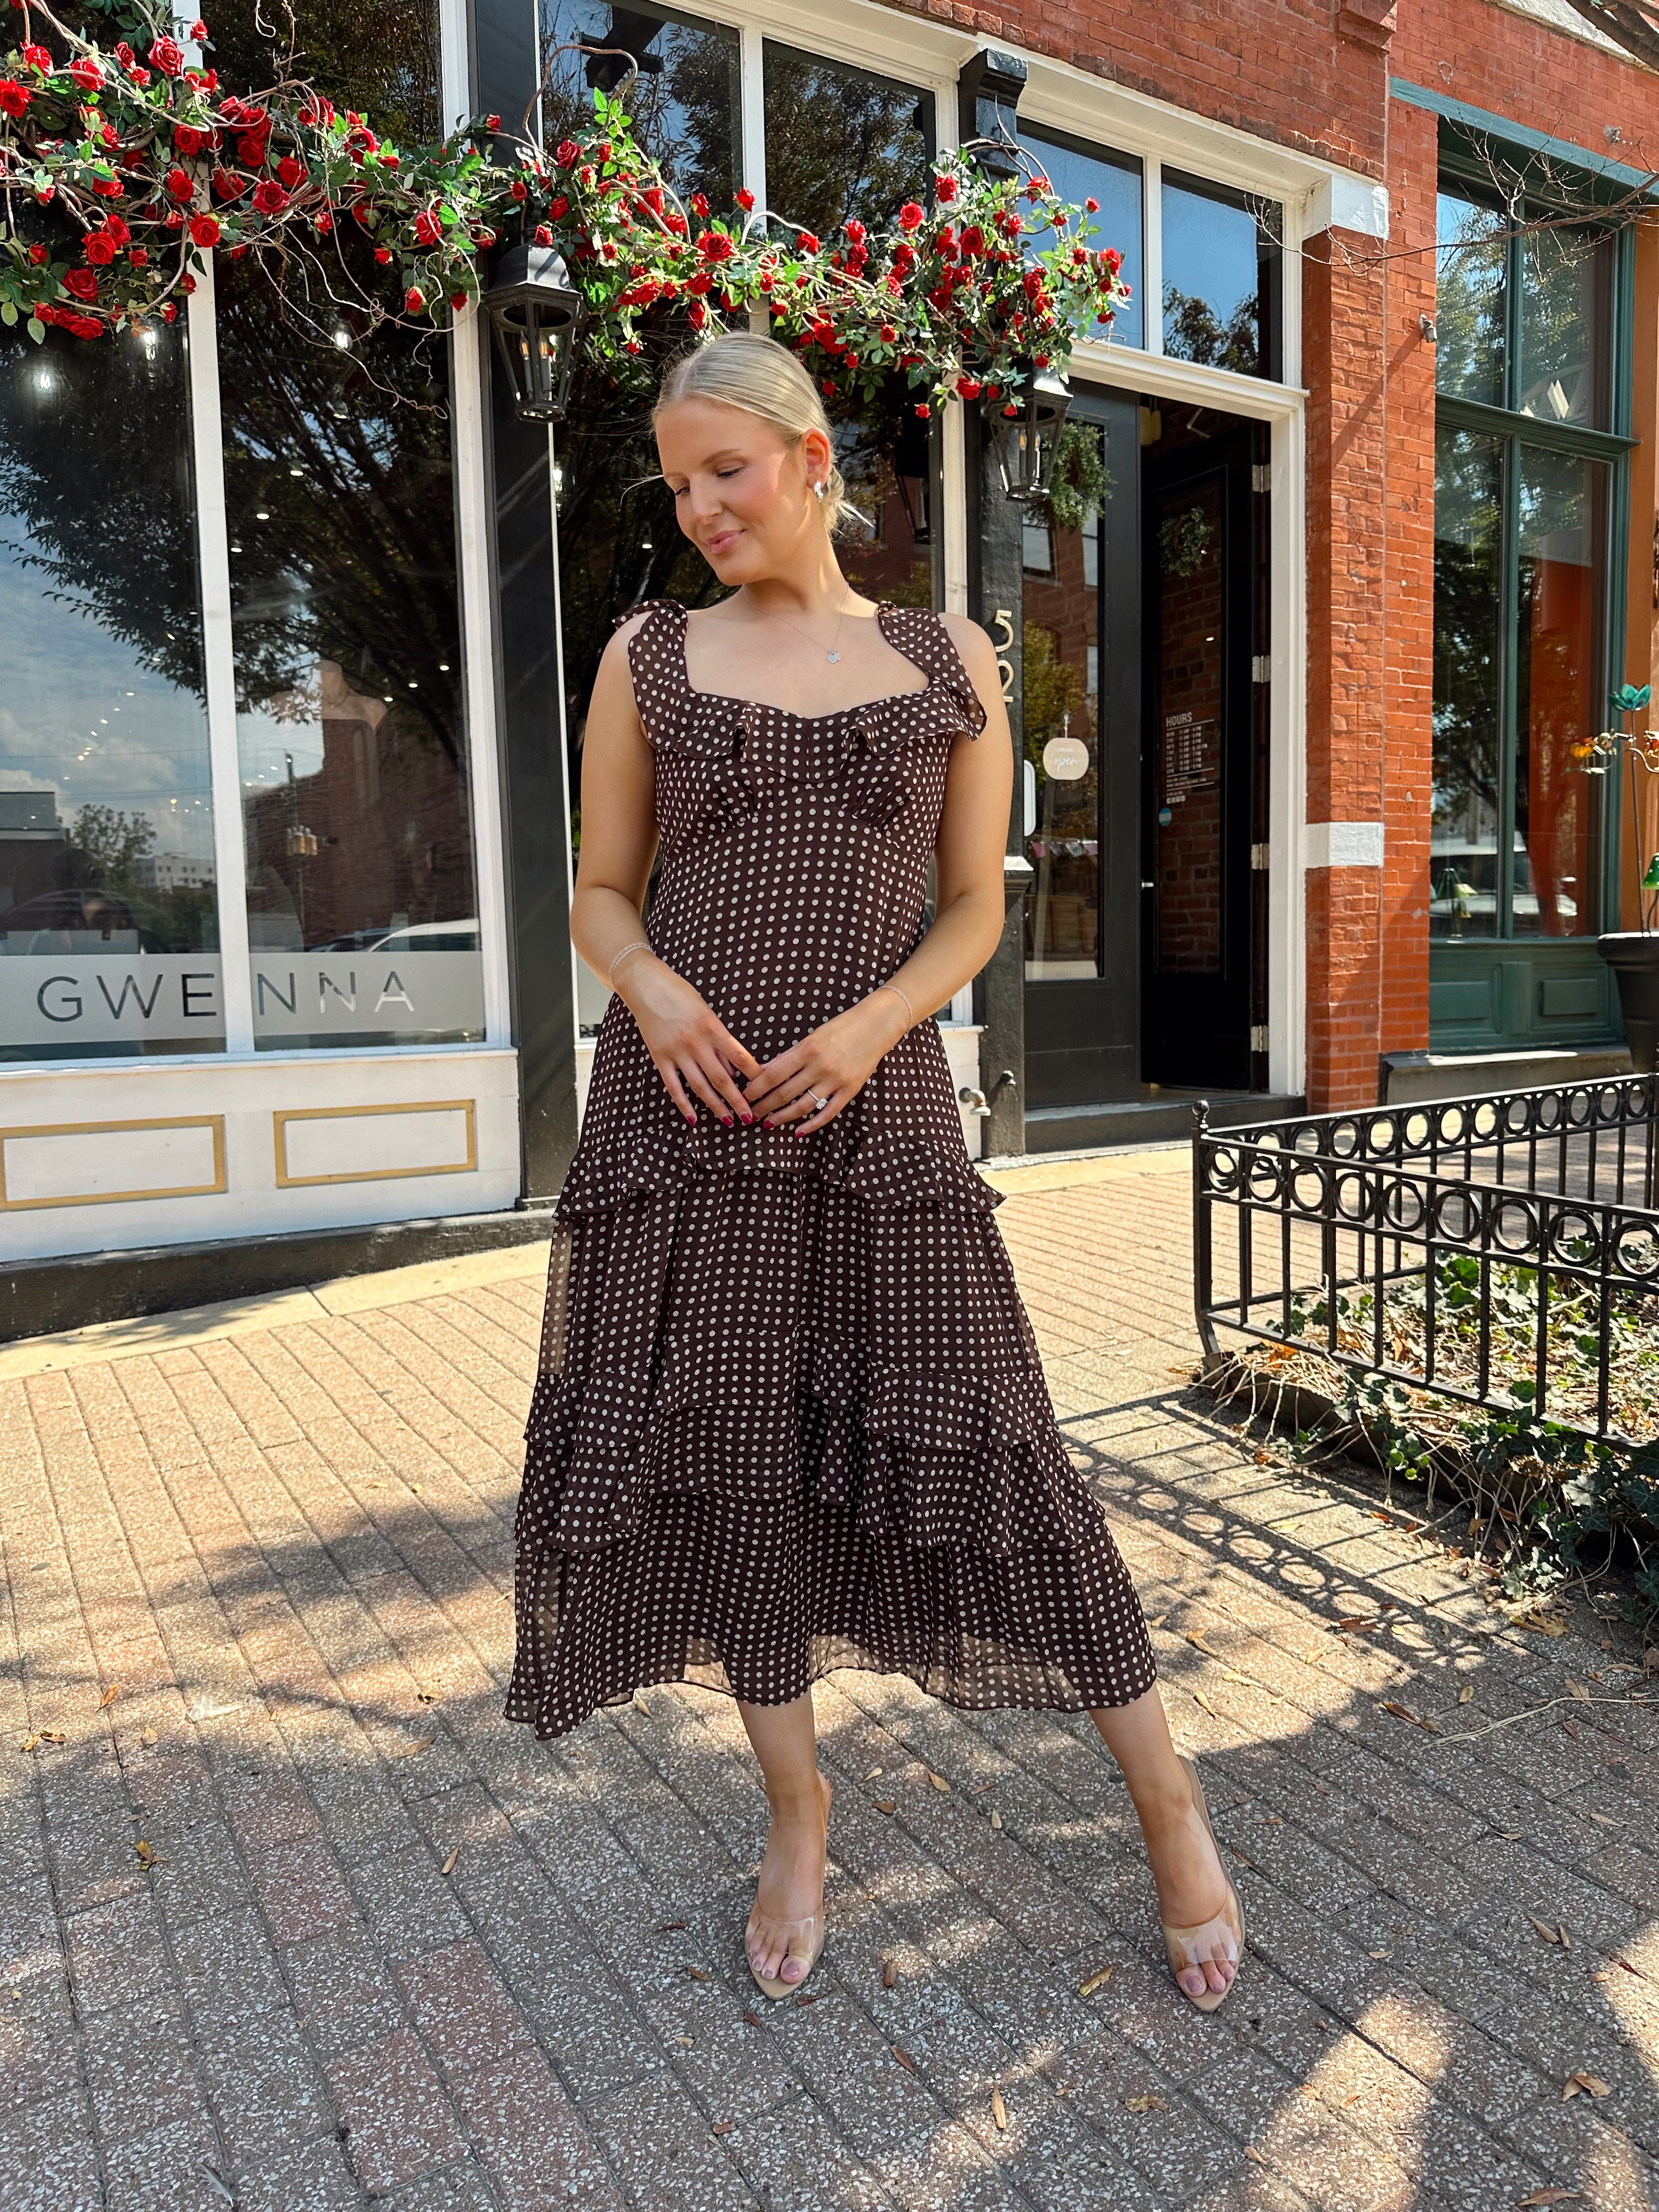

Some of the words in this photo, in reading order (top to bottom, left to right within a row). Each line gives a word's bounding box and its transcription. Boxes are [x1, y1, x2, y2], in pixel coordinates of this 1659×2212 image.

[1166, 712, 1193, 727] HOURS
[1053, 755, 1080, 773] open
[37, 971, 415, 1022] GWENNA
